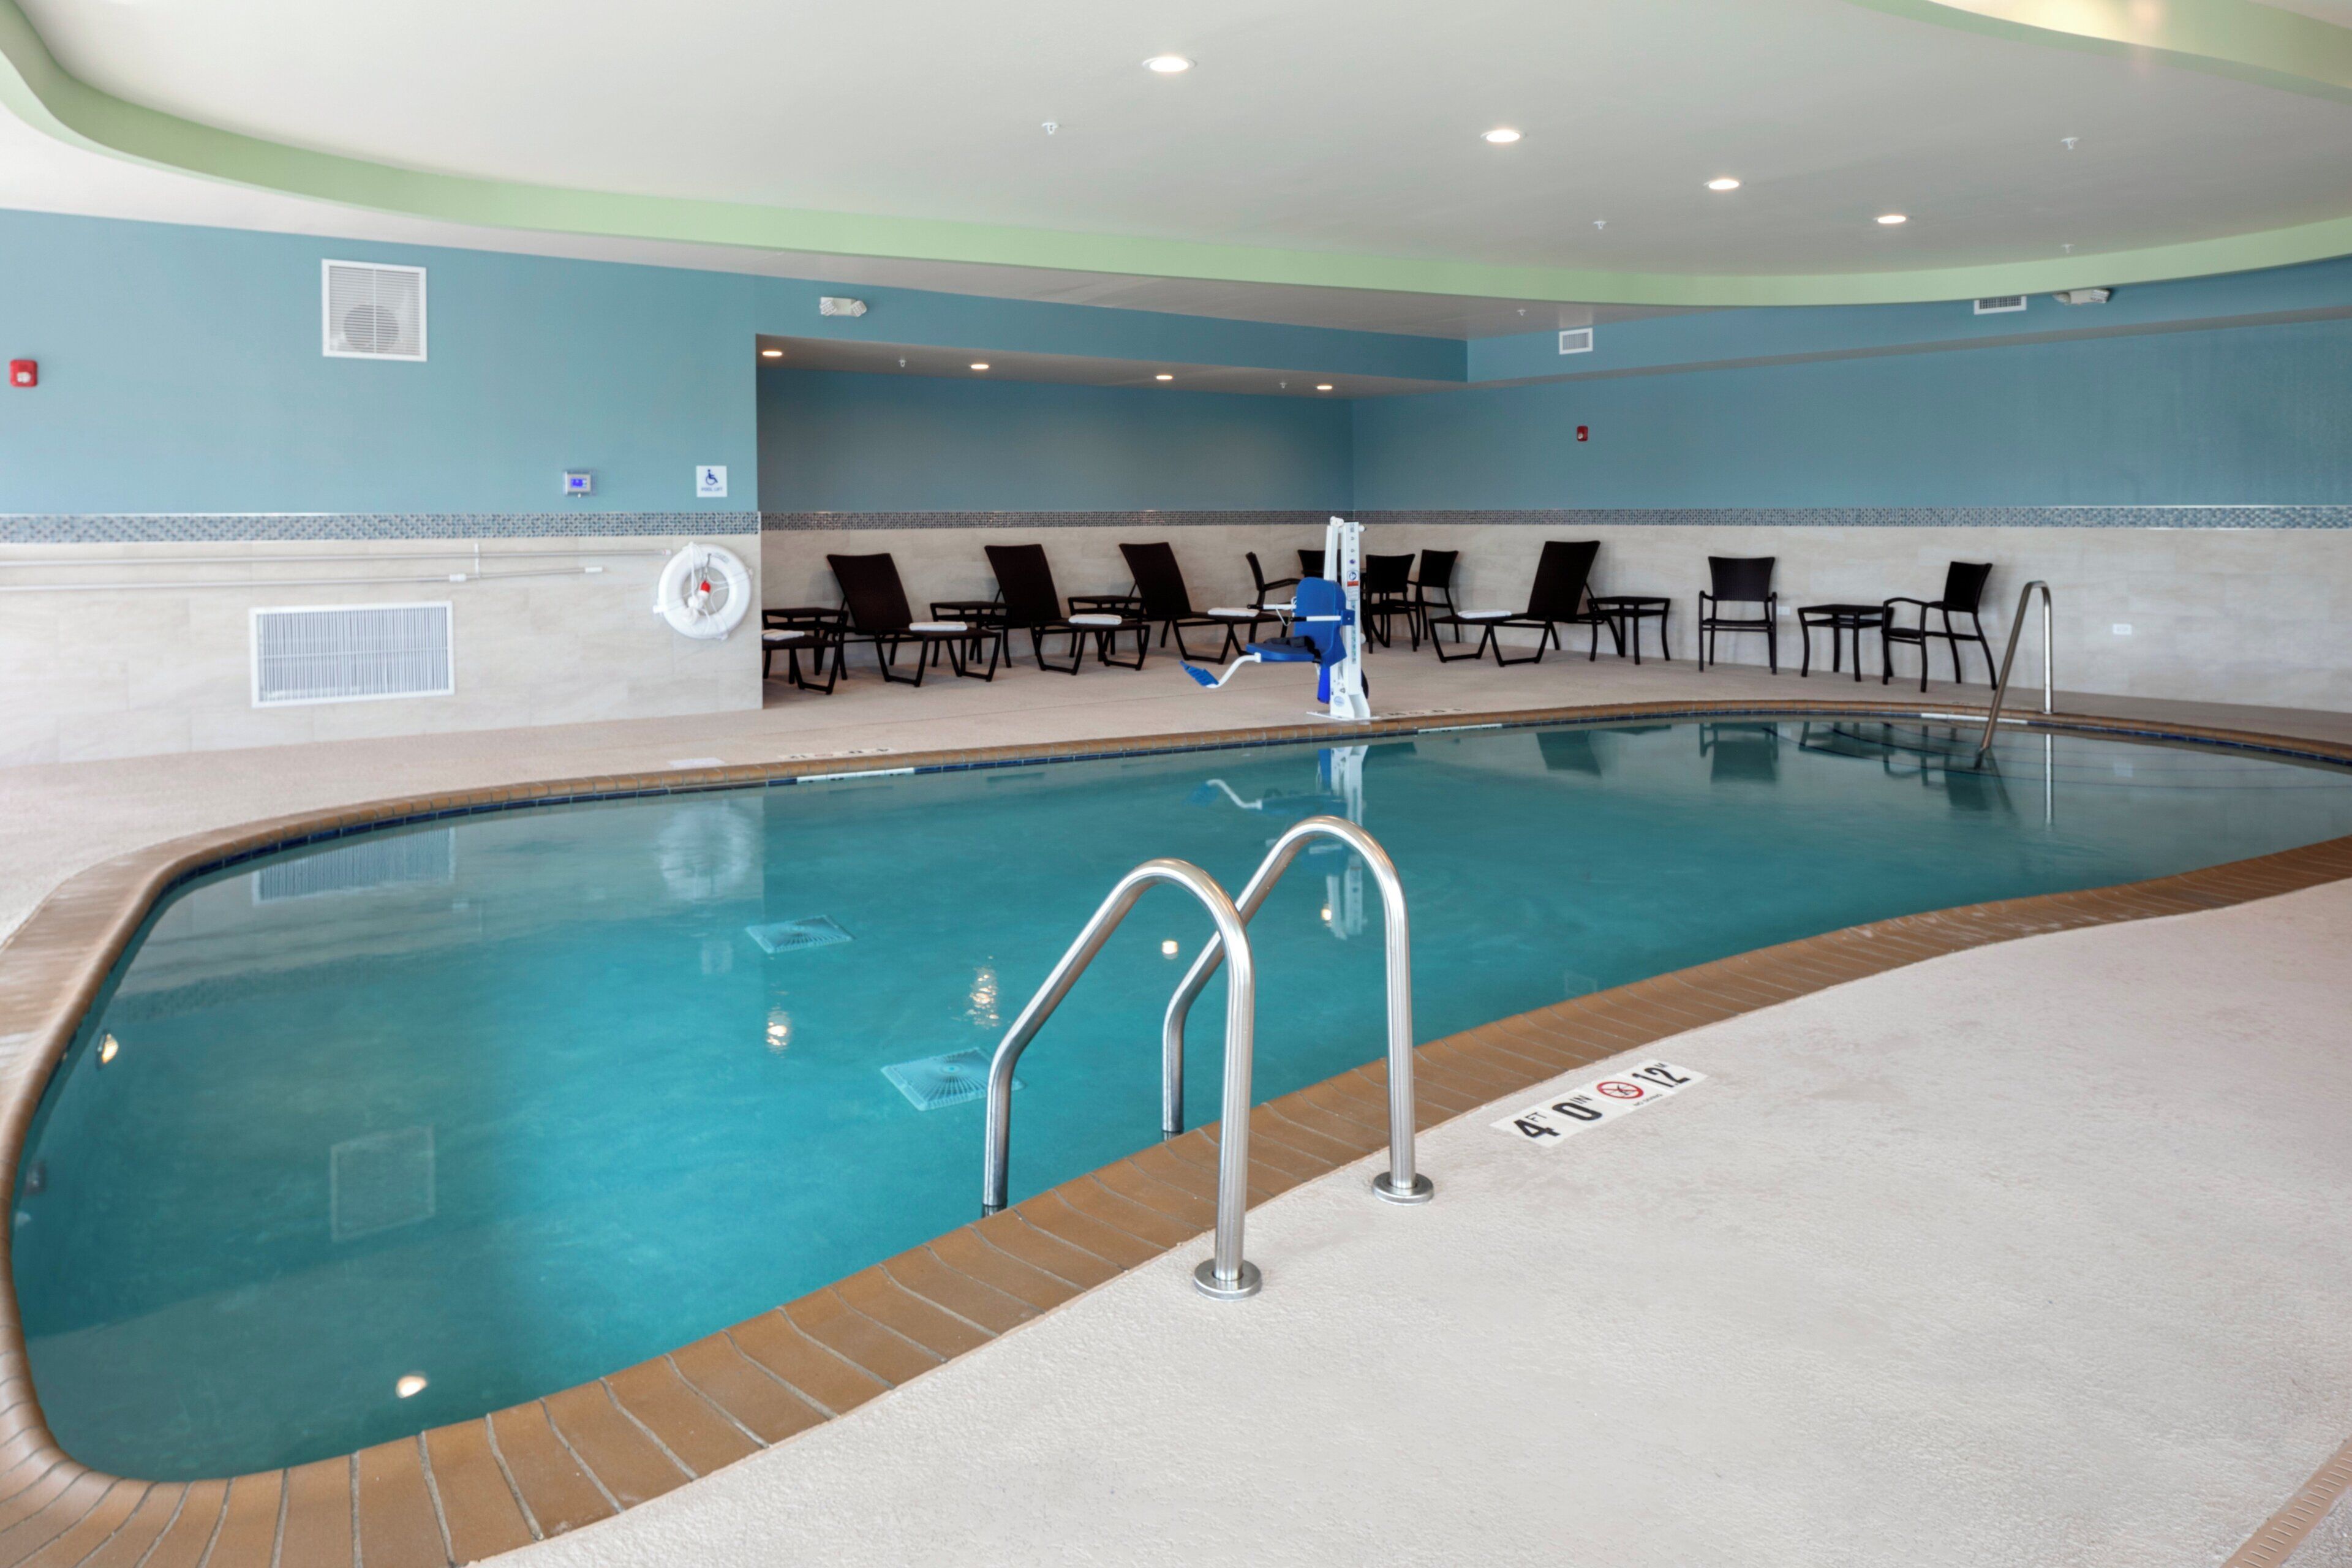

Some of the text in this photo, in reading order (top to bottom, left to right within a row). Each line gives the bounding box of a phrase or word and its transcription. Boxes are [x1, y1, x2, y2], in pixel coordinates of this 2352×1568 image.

[1569, 1095, 1593, 1104] IN
[1525, 1112, 1548, 1122] FT
[1552, 1102, 1603, 1121] 0
[1513, 1119, 1560, 1139] 4
